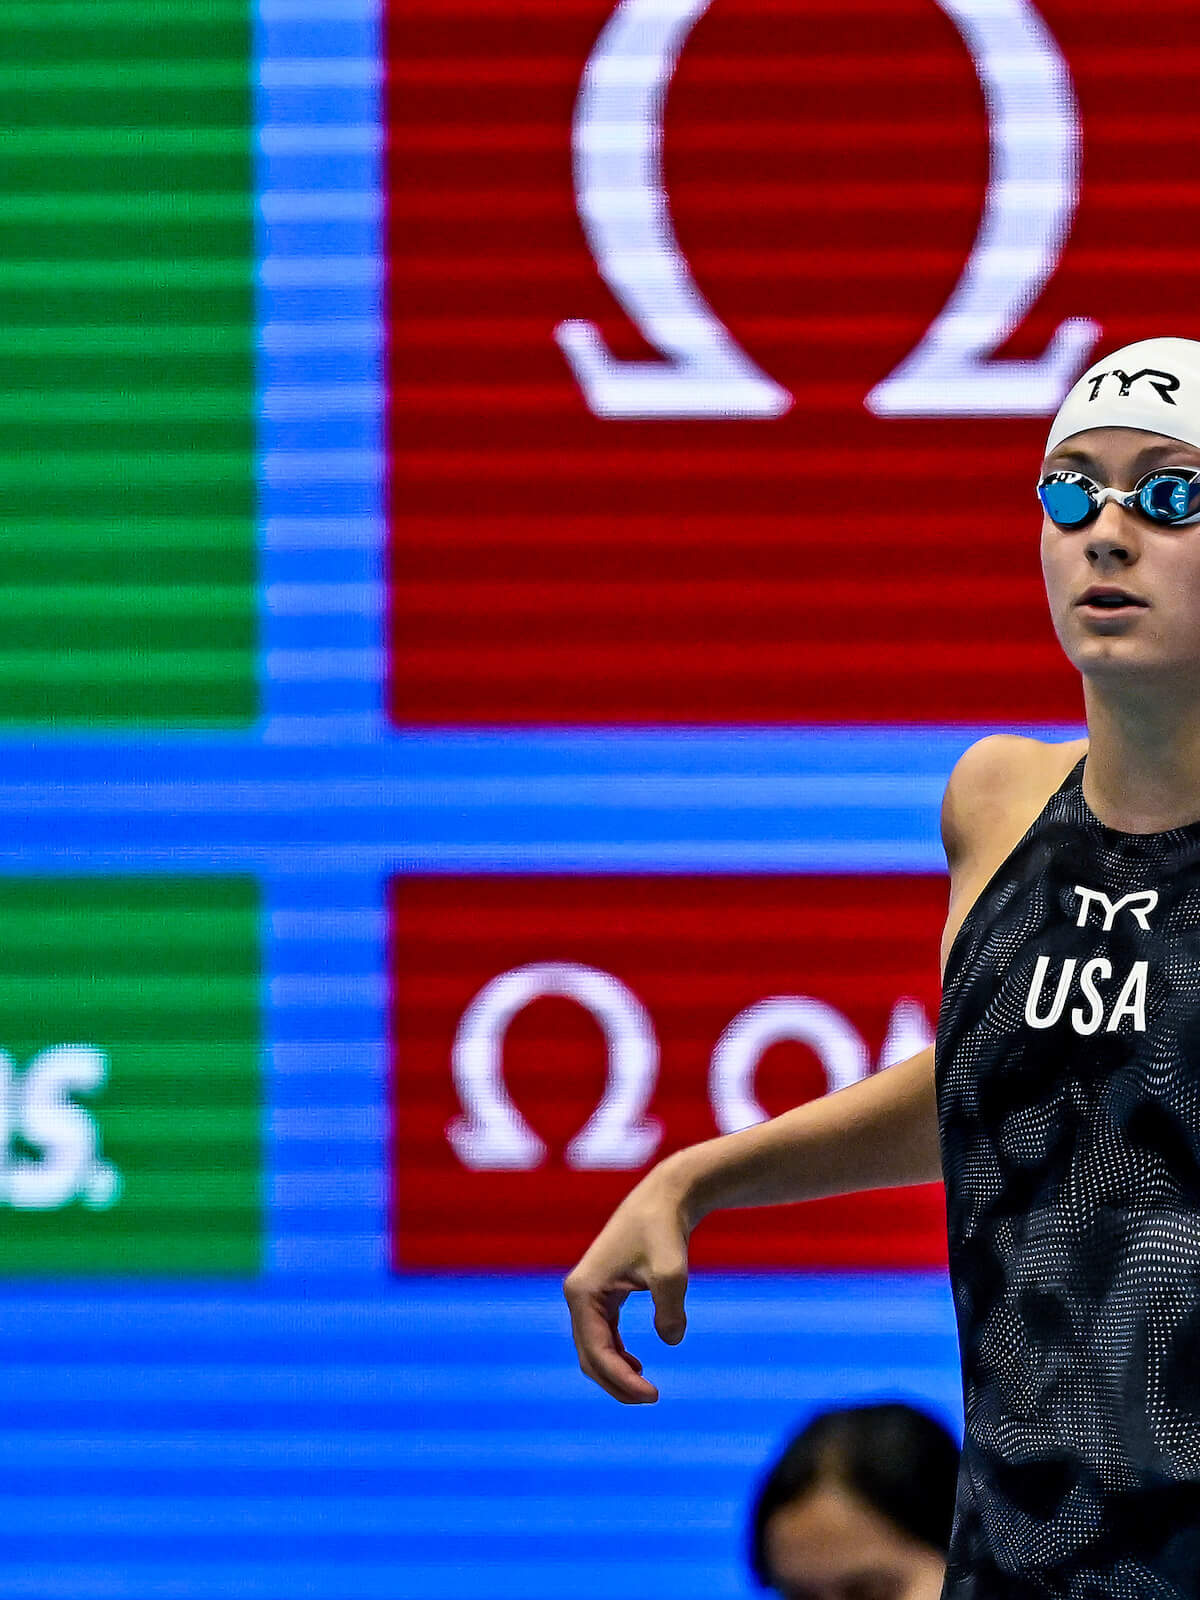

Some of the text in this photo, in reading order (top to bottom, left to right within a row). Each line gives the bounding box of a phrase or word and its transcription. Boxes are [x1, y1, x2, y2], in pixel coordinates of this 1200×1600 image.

[1088, 368, 1180, 406] TYR
[1074, 885, 1159, 931] TYR
[1025, 955, 1149, 1036] USA
